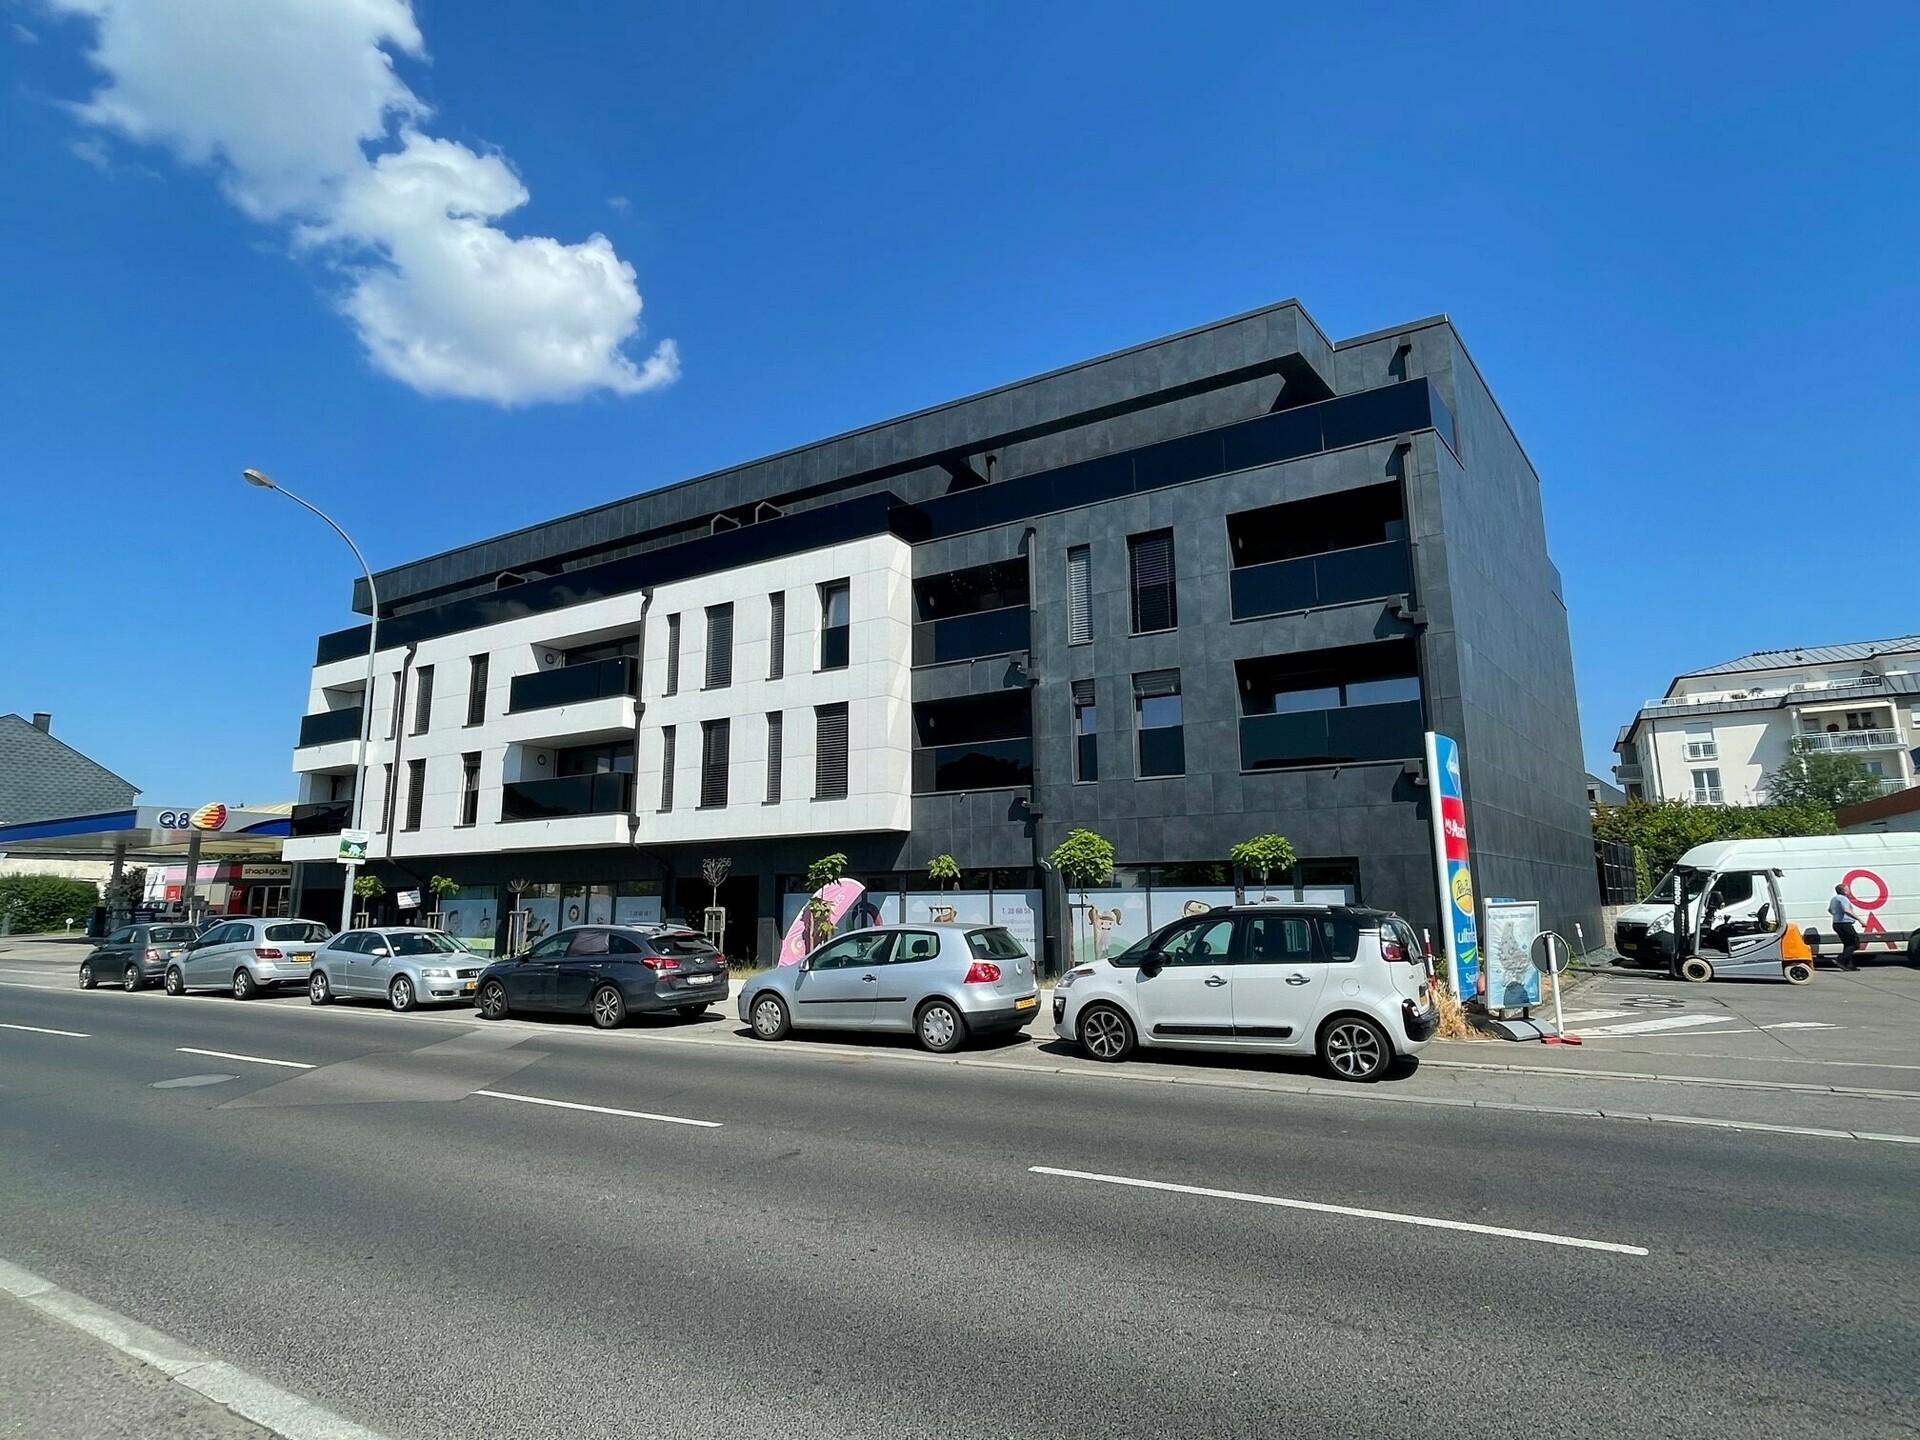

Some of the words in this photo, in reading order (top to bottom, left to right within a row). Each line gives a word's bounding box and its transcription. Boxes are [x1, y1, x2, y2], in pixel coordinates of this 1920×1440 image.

[158, 811, 190, 829] Q8
[1673, 875, 1682, 906] mateco
[1731, 940, 1757, 951] mateco
